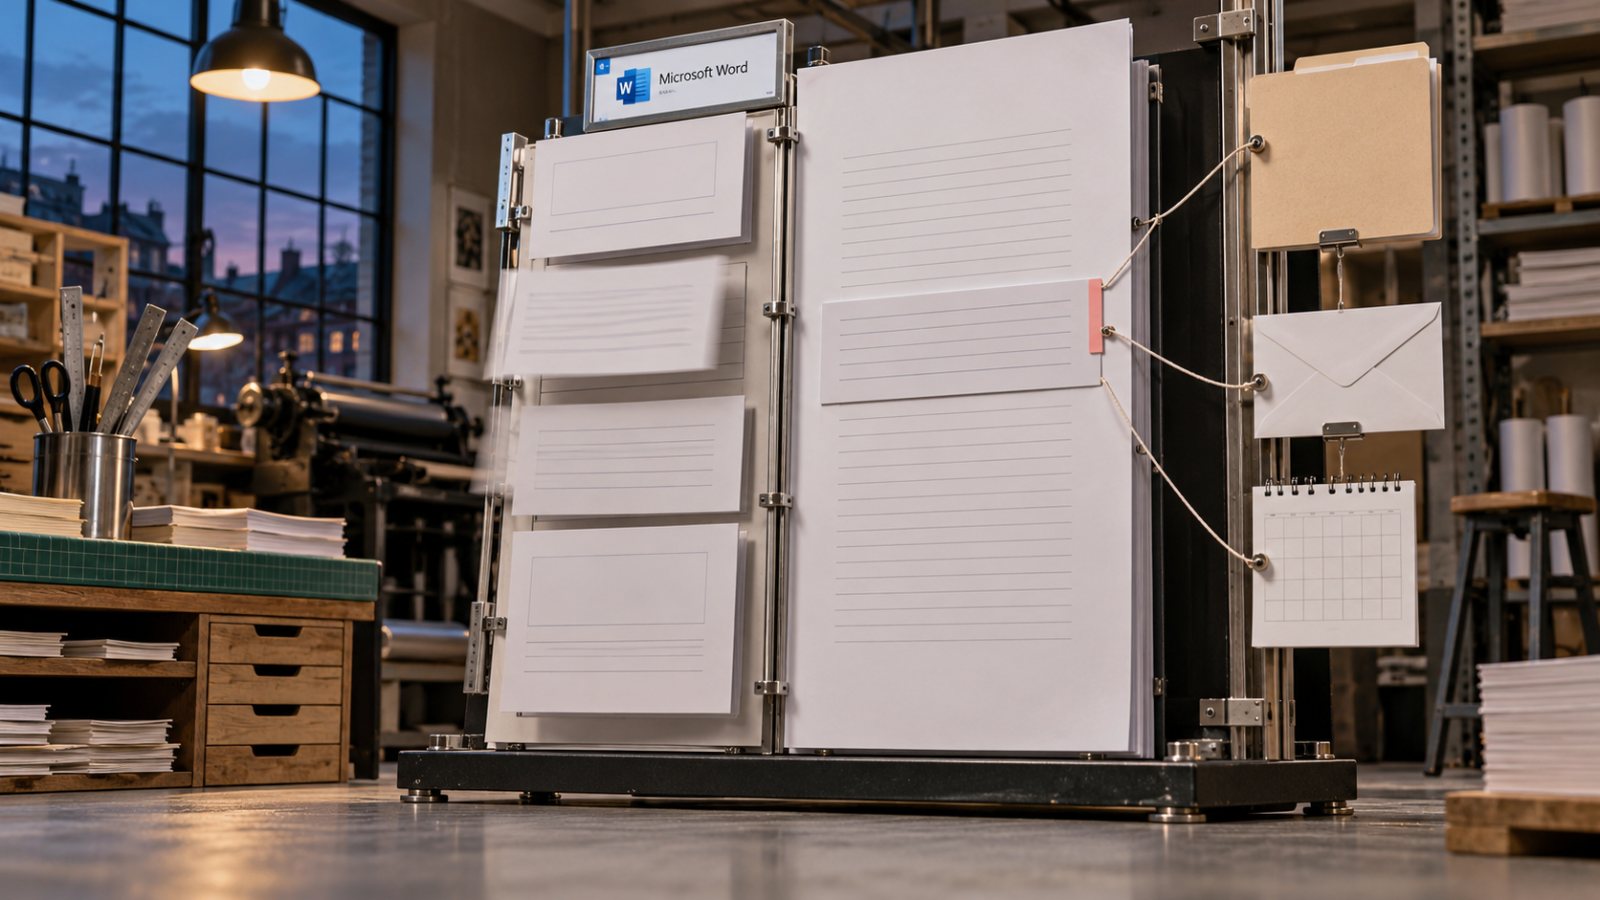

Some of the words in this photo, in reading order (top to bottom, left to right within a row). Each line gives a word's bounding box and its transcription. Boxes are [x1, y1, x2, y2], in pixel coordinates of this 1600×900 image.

[659, 66, 713, 85] Microsoft
[716, 60, 748, 76] Word
[619, 81, 633, 95] W
